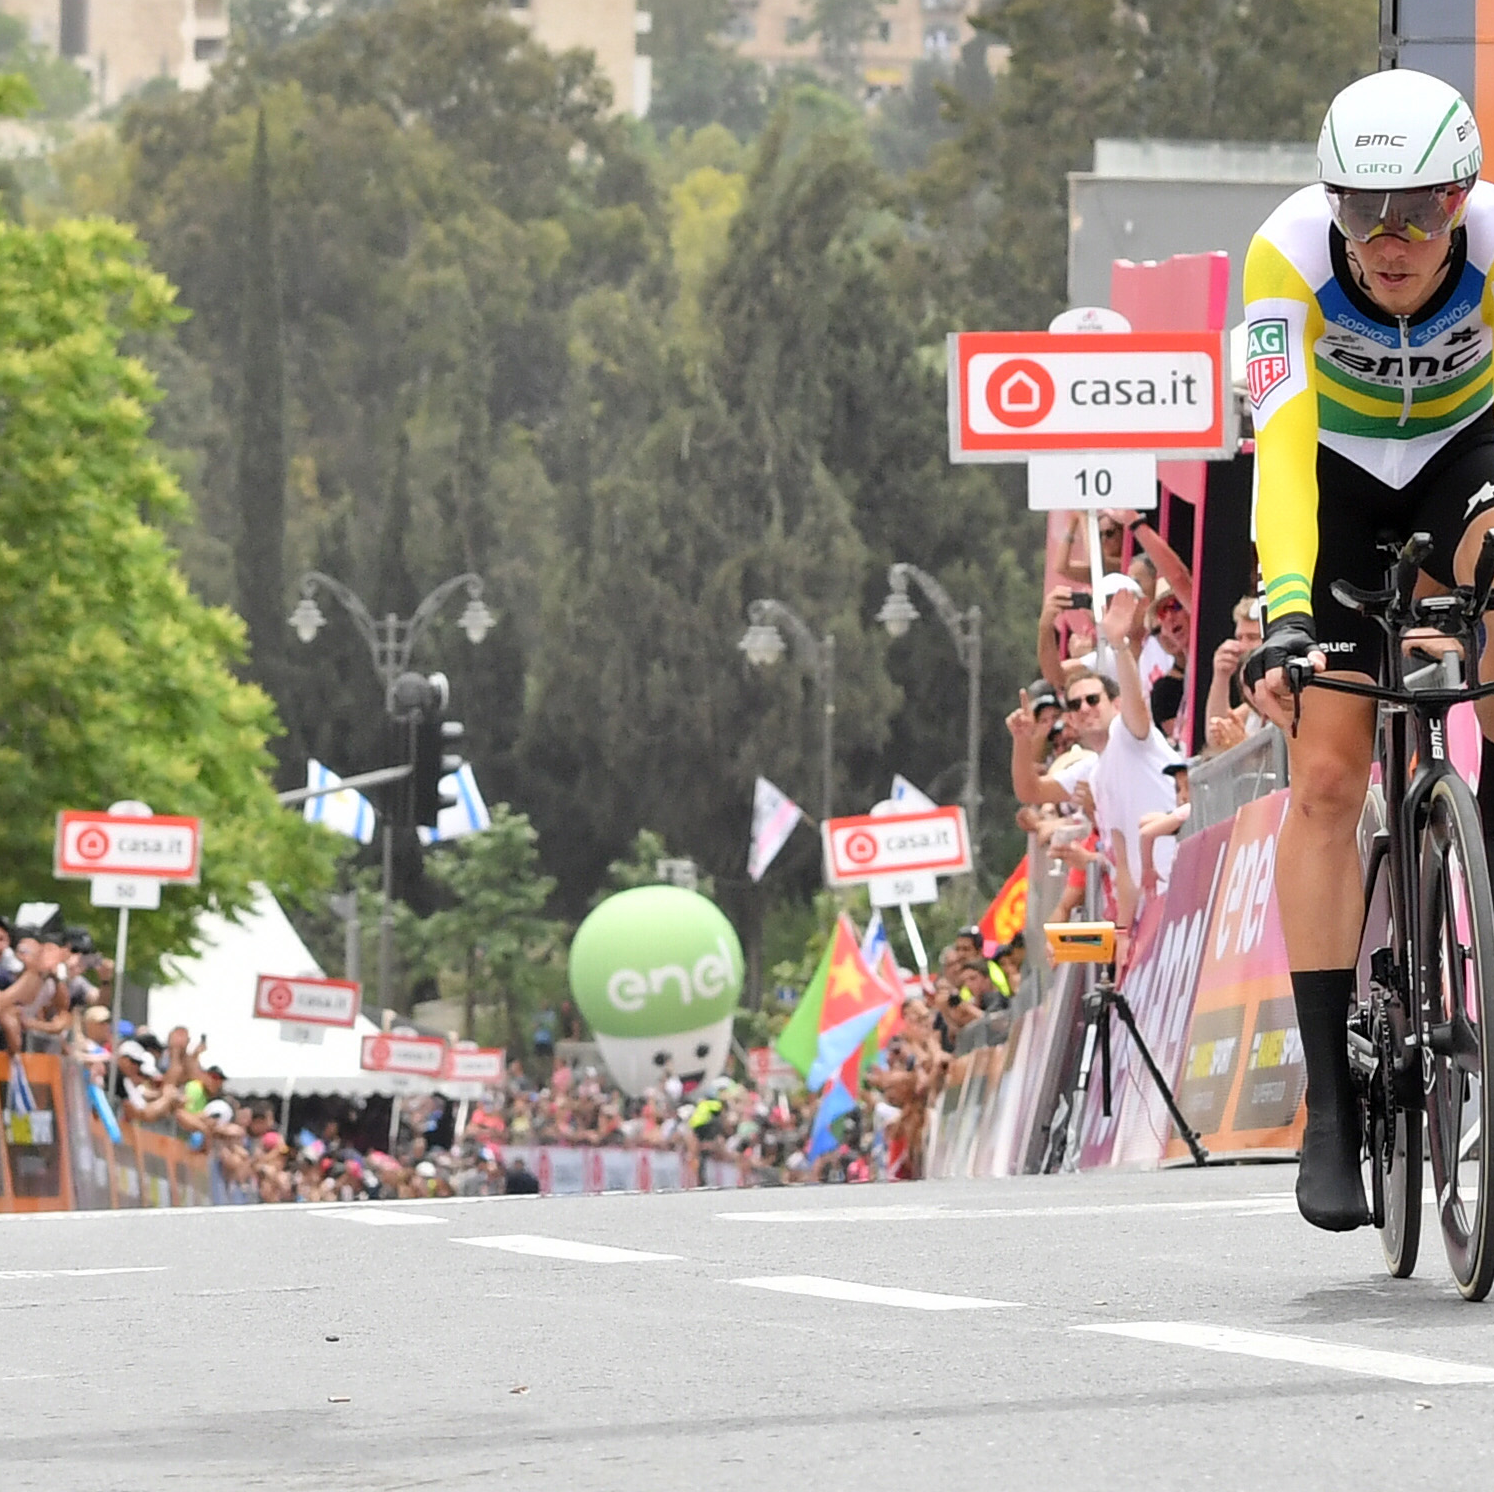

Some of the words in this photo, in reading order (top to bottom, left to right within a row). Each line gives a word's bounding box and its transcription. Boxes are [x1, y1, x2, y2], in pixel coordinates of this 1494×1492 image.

[1355, 134, 1408, 148] BMC
[1356, 163, 1402, 175] GIRO
[1335, 313, 1395, 347] SOPHOS
[1415, 299, 1472, 344] SOPHOS
[1070, 369, 1197, 406] casa.it
[1074, 468, 1112, 497] 10
[1431, 717, 1444, 761] BMC
[117, 836, 183, 857] casa.it
[885, 829, 951, 852] casa.it
[1214, 797, 1290, 960] enel
[608, 934, 737, 1011] enel
